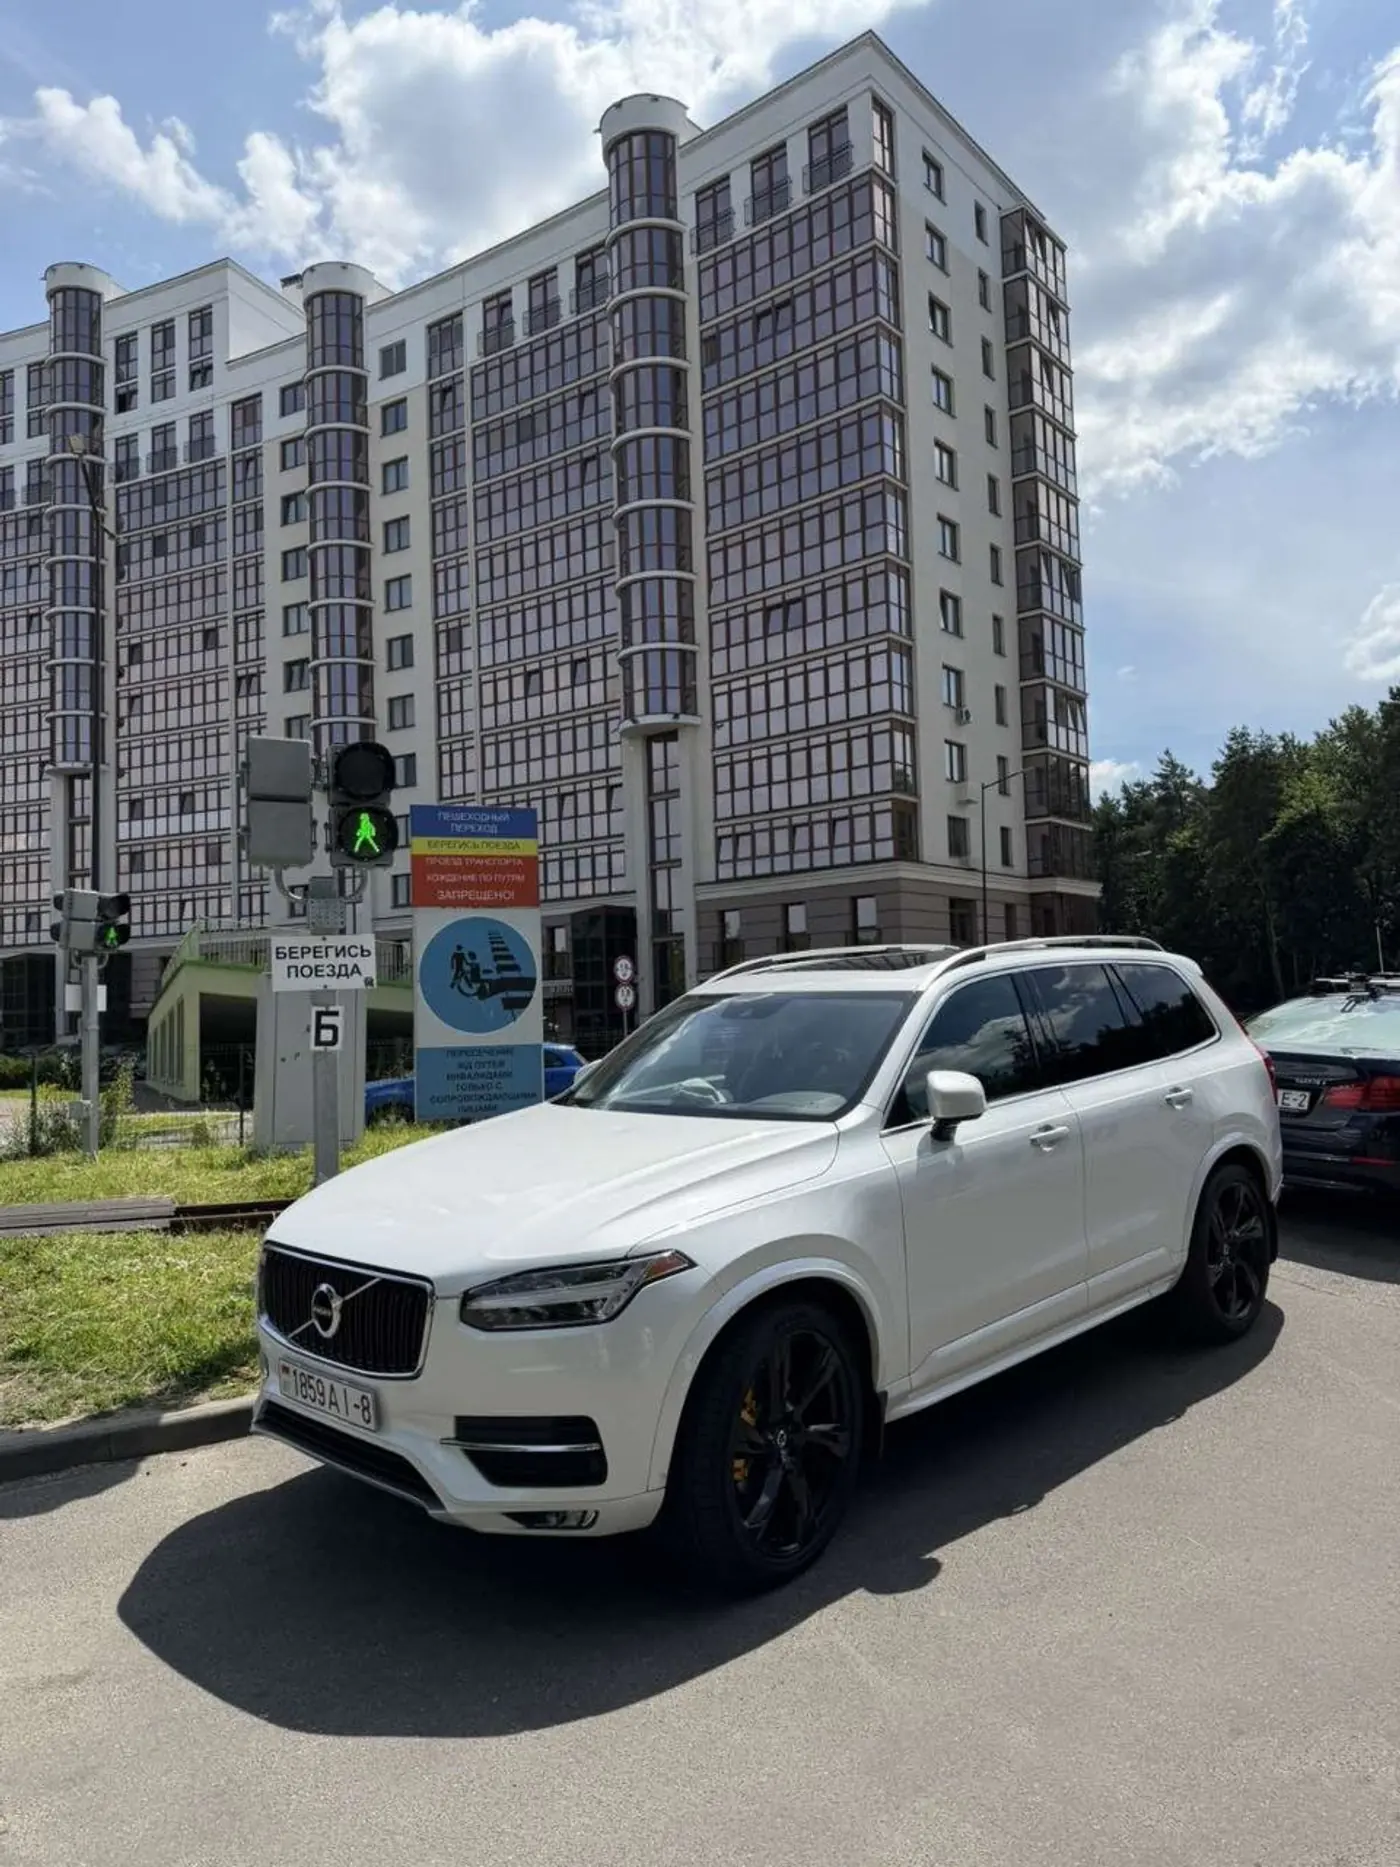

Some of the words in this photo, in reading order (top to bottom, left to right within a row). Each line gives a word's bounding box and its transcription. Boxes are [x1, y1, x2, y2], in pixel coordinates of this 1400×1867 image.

[451, 823, 498, 834] ПЕРЕХОД
[481, 840, 521, 850] ПОЕЗДА
[464, 857, 524, 866] ТРАНСПОРТА
[437, 889, 515, 901] ЗАПРЕЩЕНО!
[275, 945, 372, 960] БЕРЕГИСЬ
[287, 963, 362, 979] ПОЕЗДА
